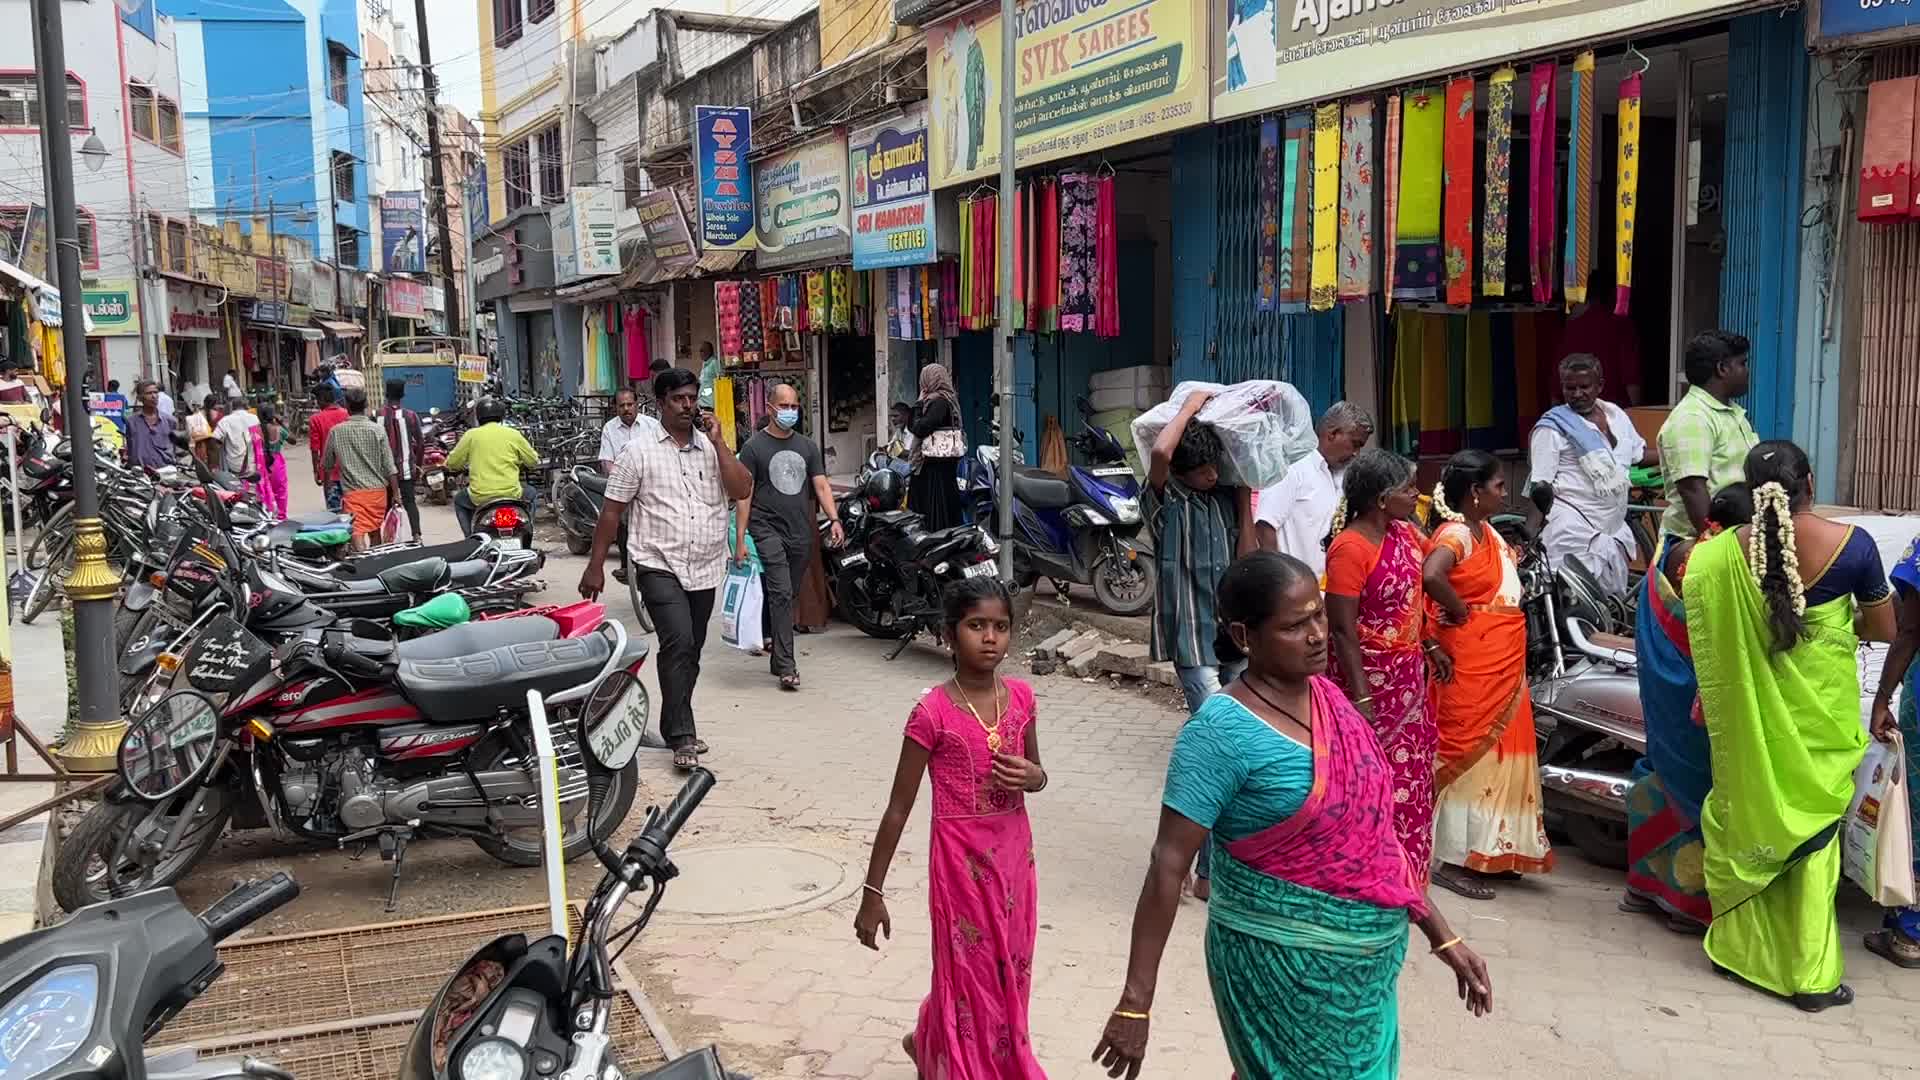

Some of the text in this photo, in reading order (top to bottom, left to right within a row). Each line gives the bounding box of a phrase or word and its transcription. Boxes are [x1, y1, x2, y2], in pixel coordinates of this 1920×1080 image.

[1023, 33, 1070, 86] SVK
[1078, 7, 1151, 60] SAREES
[1093, 126, 1104, 139] 625
[704, 198, 752, 212] Textiles
[706, 213, 725, 222] Whole
[857, 203, 925, 234] SRI KAMATCHI
[706, 231, 738, 241] Merchants
[887, 228, 927, 252] TEXTILES
